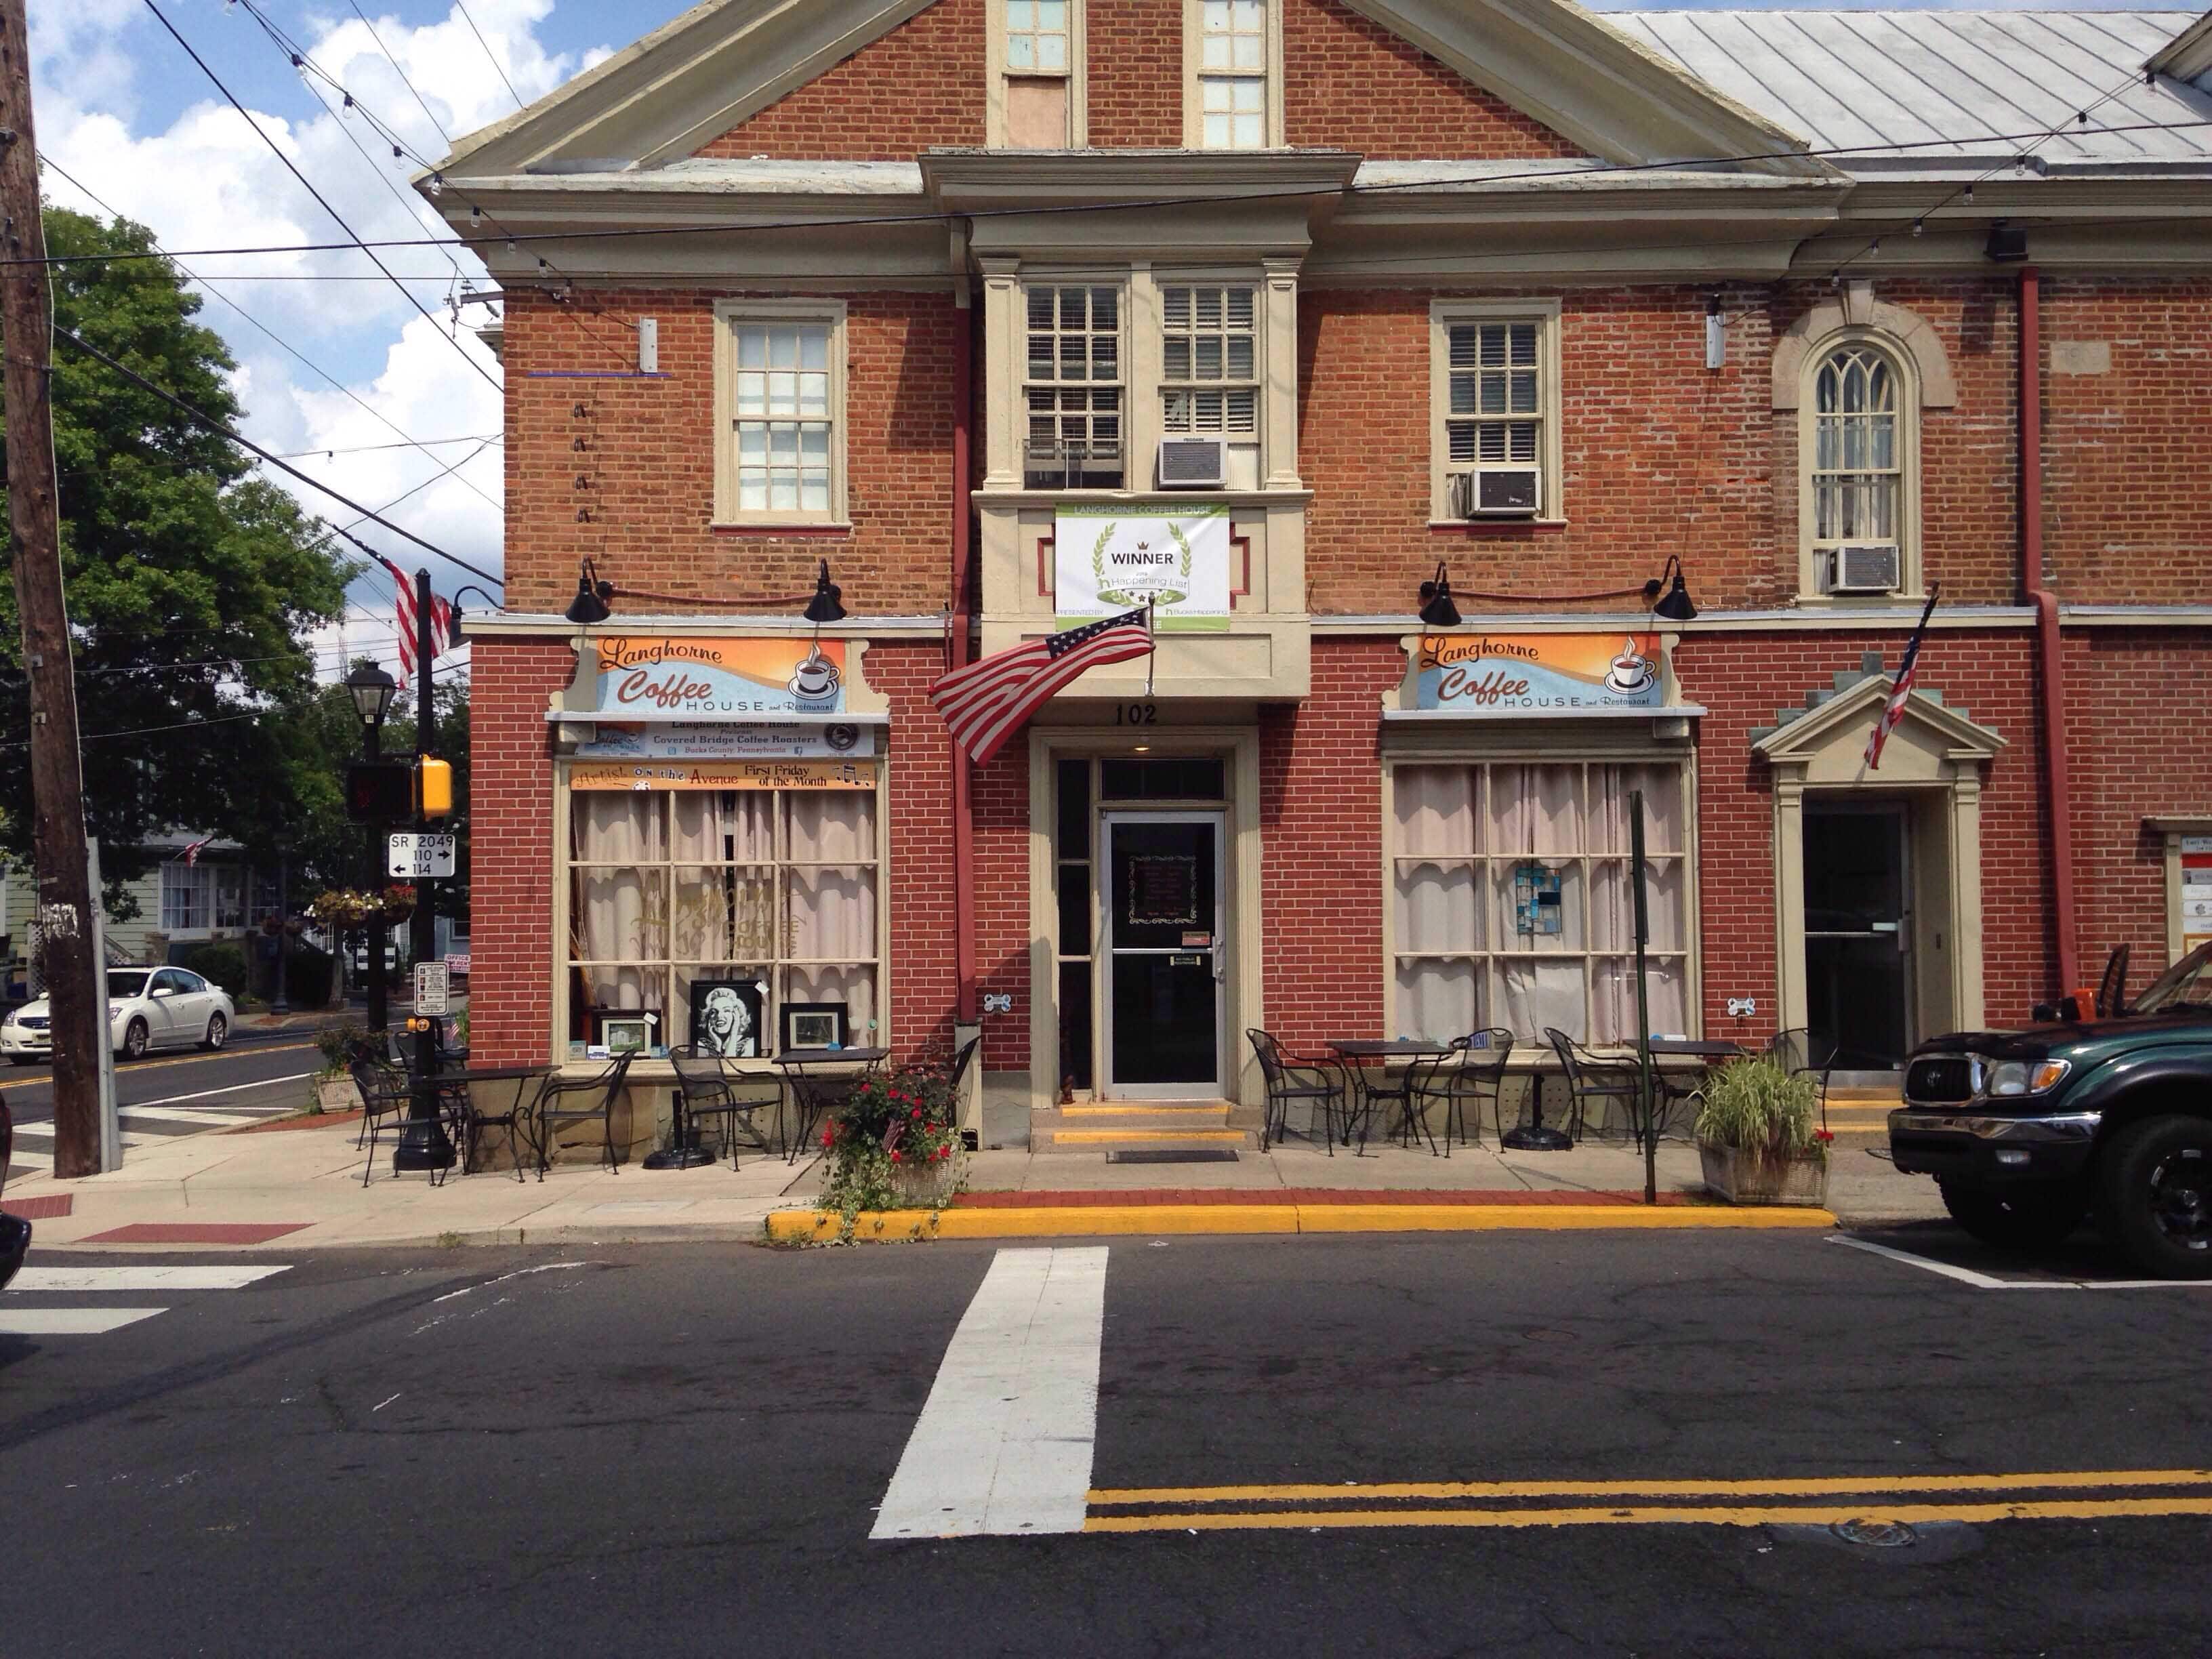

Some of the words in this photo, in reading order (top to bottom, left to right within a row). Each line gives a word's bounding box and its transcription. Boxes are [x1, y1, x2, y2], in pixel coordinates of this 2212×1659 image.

[1074, 506, 1136, 514] LANGHORNE
[1139, 506, 1176, 514] COFFEE
[1179, 506, 1211, 514] HOUSE
[1111, 552, 1174, 565] WINNER
[1111, 576, 1167, 588] Happening
[1169, 577, 1187, 589] List
[600, 637, 722, 671] Langhorne
[1420, 636, 1538, 669] Langhorne
[617, 670, 713, 708] Coffee
[1437, 668, 1530, 705] Coffee
[687, 701, 764, 711] HOUSE
[783, 701, 834, 712] Restaurant
[1504, 697, 1580, 707] HOUSE
[1599, 696, 1650, 706] Restaurant
[1116, 705, 1156, 724] 102
[653, 735, 696, 743] Covered
[699, 735, 733, 745] Bridge
[737, 735, 768, 743] Coffee
[772, 735, 817, 743] Roasters
[737, 746, 786, 754] Pennsylvania
[661, 769, 684, 780] the
[690, 769, 738, 784] Avenue
[745, 765, 771, 775] First
[774, 765, 810, 777] Friday
[759, 776, 770, 787] of
[777, 777, 790, 786] the
[794, 777, 827, 787] Month
[392, 836, 409, 847] SR
[418, 836, 453, 847] 2049
[413, 850, 432, 861] 110
[413, 864, 430, 874] 114
